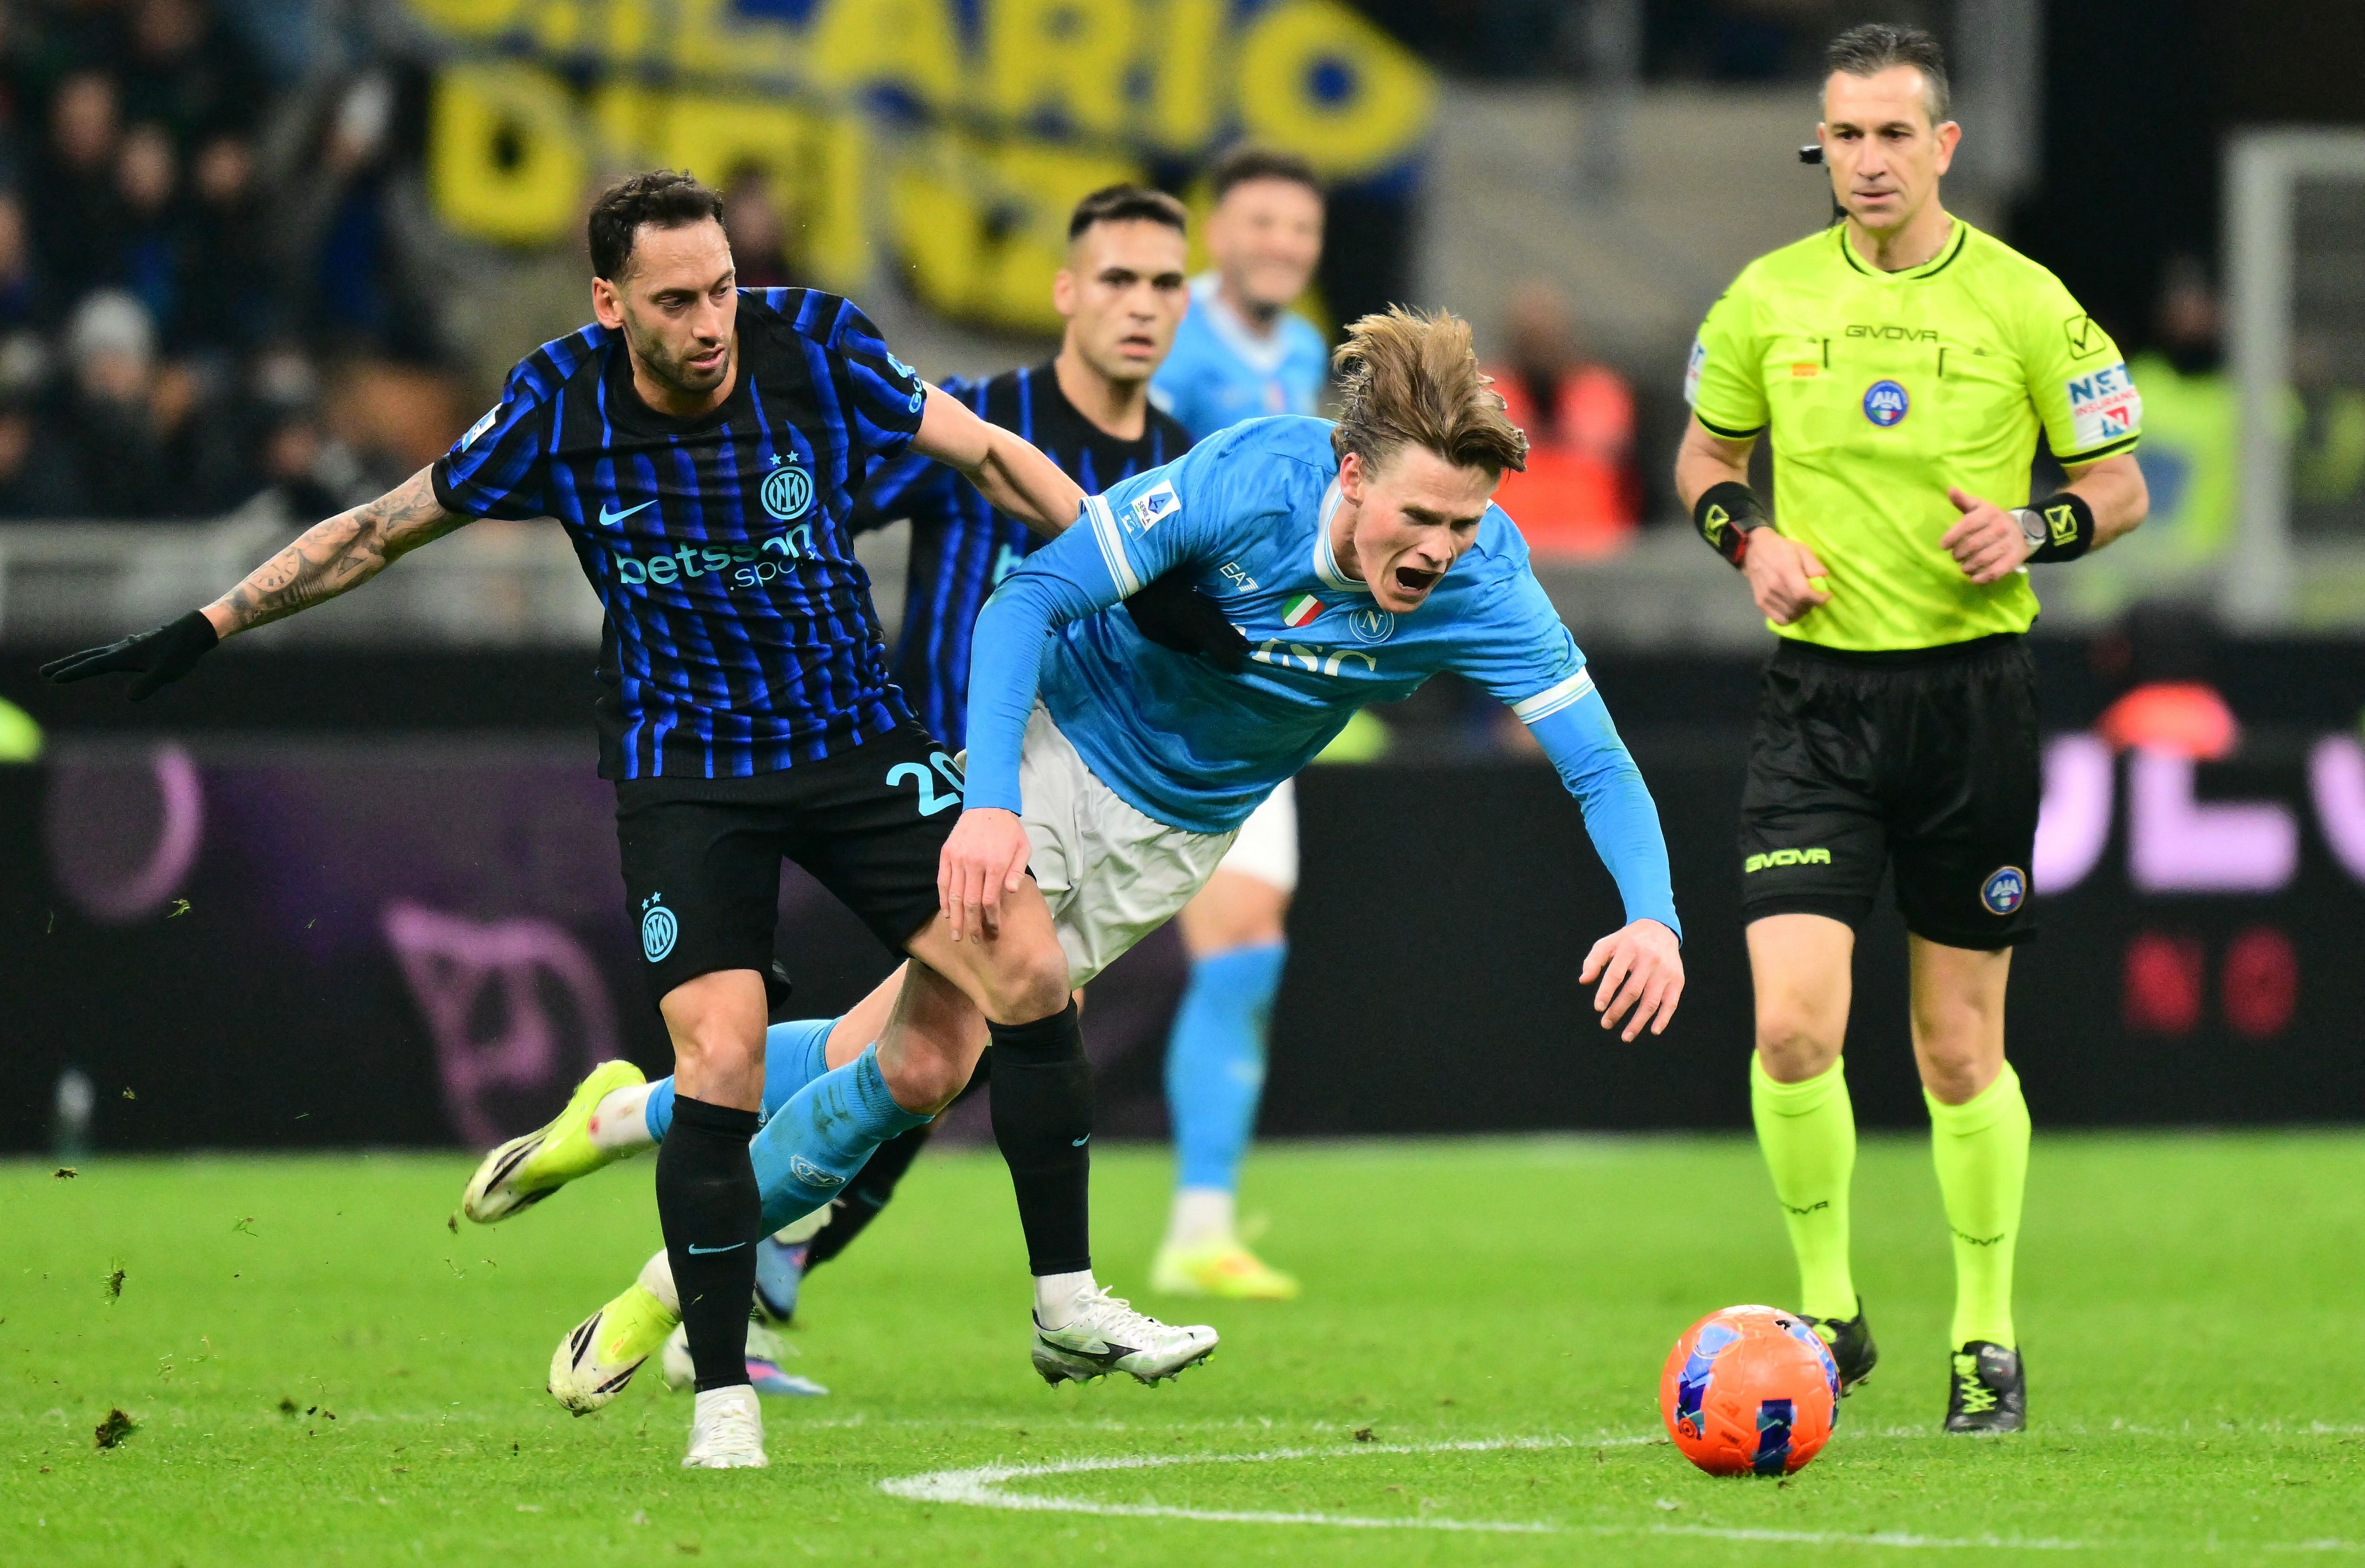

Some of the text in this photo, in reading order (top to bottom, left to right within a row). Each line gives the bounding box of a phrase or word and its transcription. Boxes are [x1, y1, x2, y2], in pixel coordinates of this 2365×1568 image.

[1845, 324, 1938, 343] GIVOVA
[1138, 501, 1149, 518] SERIE
[1359, 609, 1384, 633] N
[886, 751, 965, 817] 20
